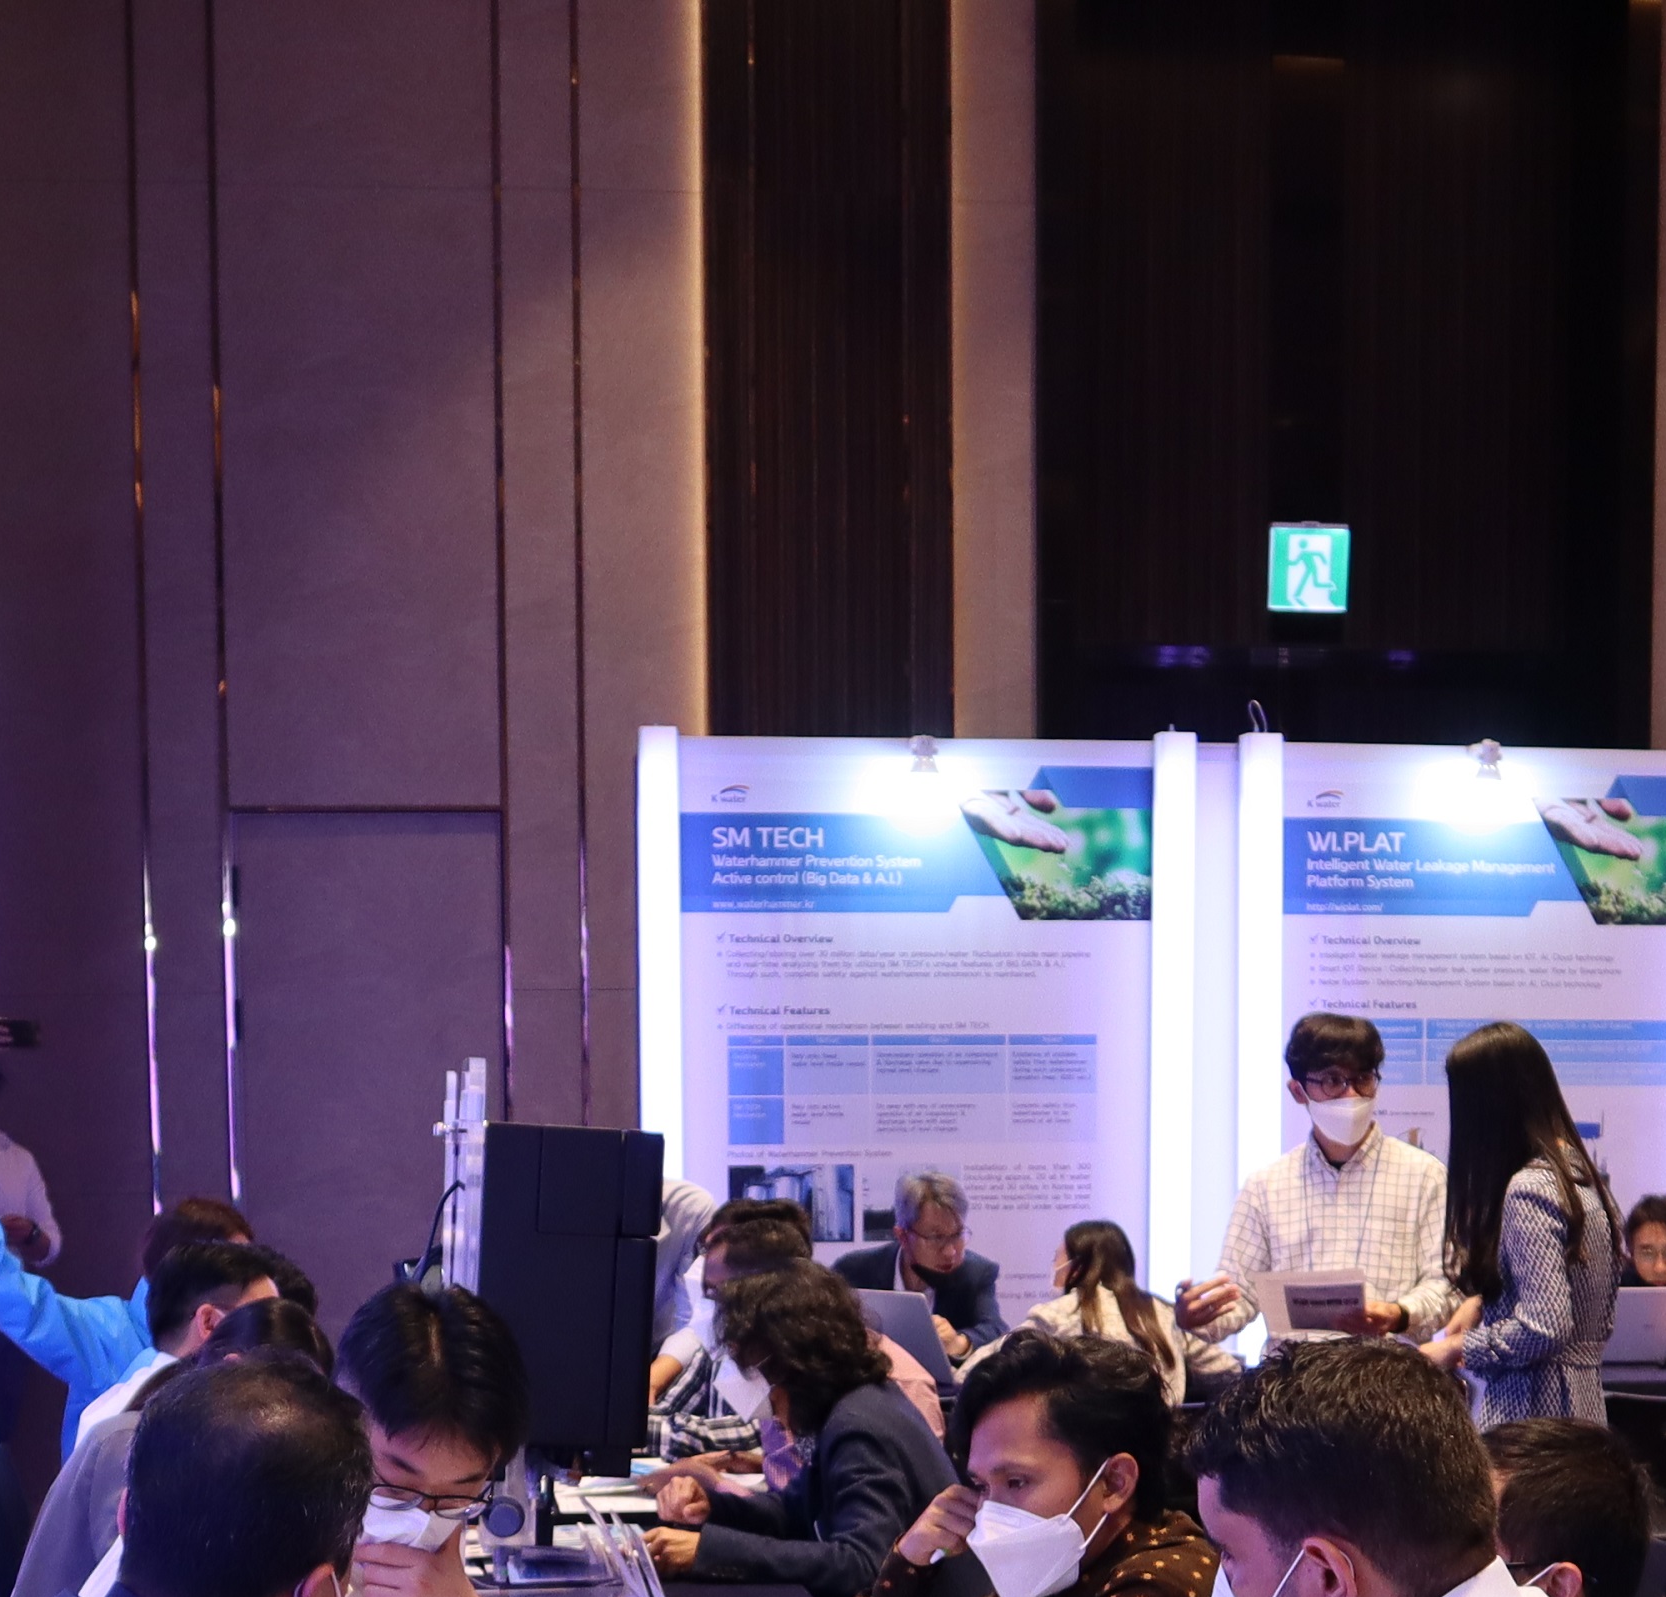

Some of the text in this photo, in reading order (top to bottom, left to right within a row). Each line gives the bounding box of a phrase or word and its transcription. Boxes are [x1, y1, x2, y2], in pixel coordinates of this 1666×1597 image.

[711, 826, 825, 849] SM TECH
[1306, 830, 1407, 853] WI.PLAT
[711, 853, 923, 870] Waterhammer Prevention System
[1306, 857, 1556, 876] Intelligent Water Leakage Management
[711, 870, 753, 886] Active
[755, 870, 799, 886] control
[801, 870, 827, 888] (Big
[829, 871, 860, 886] Data
[862, 871, 873, 886] &
[1306, 874, 1415, 890] Platform System
[729, 932, 835, 944] Technical Overview
[1322, 935, 1422, 946] Technical Overview
[729, 1005, 831, 1016] Technical Features
[1321, 999, 1418, 1010] Technical Features
